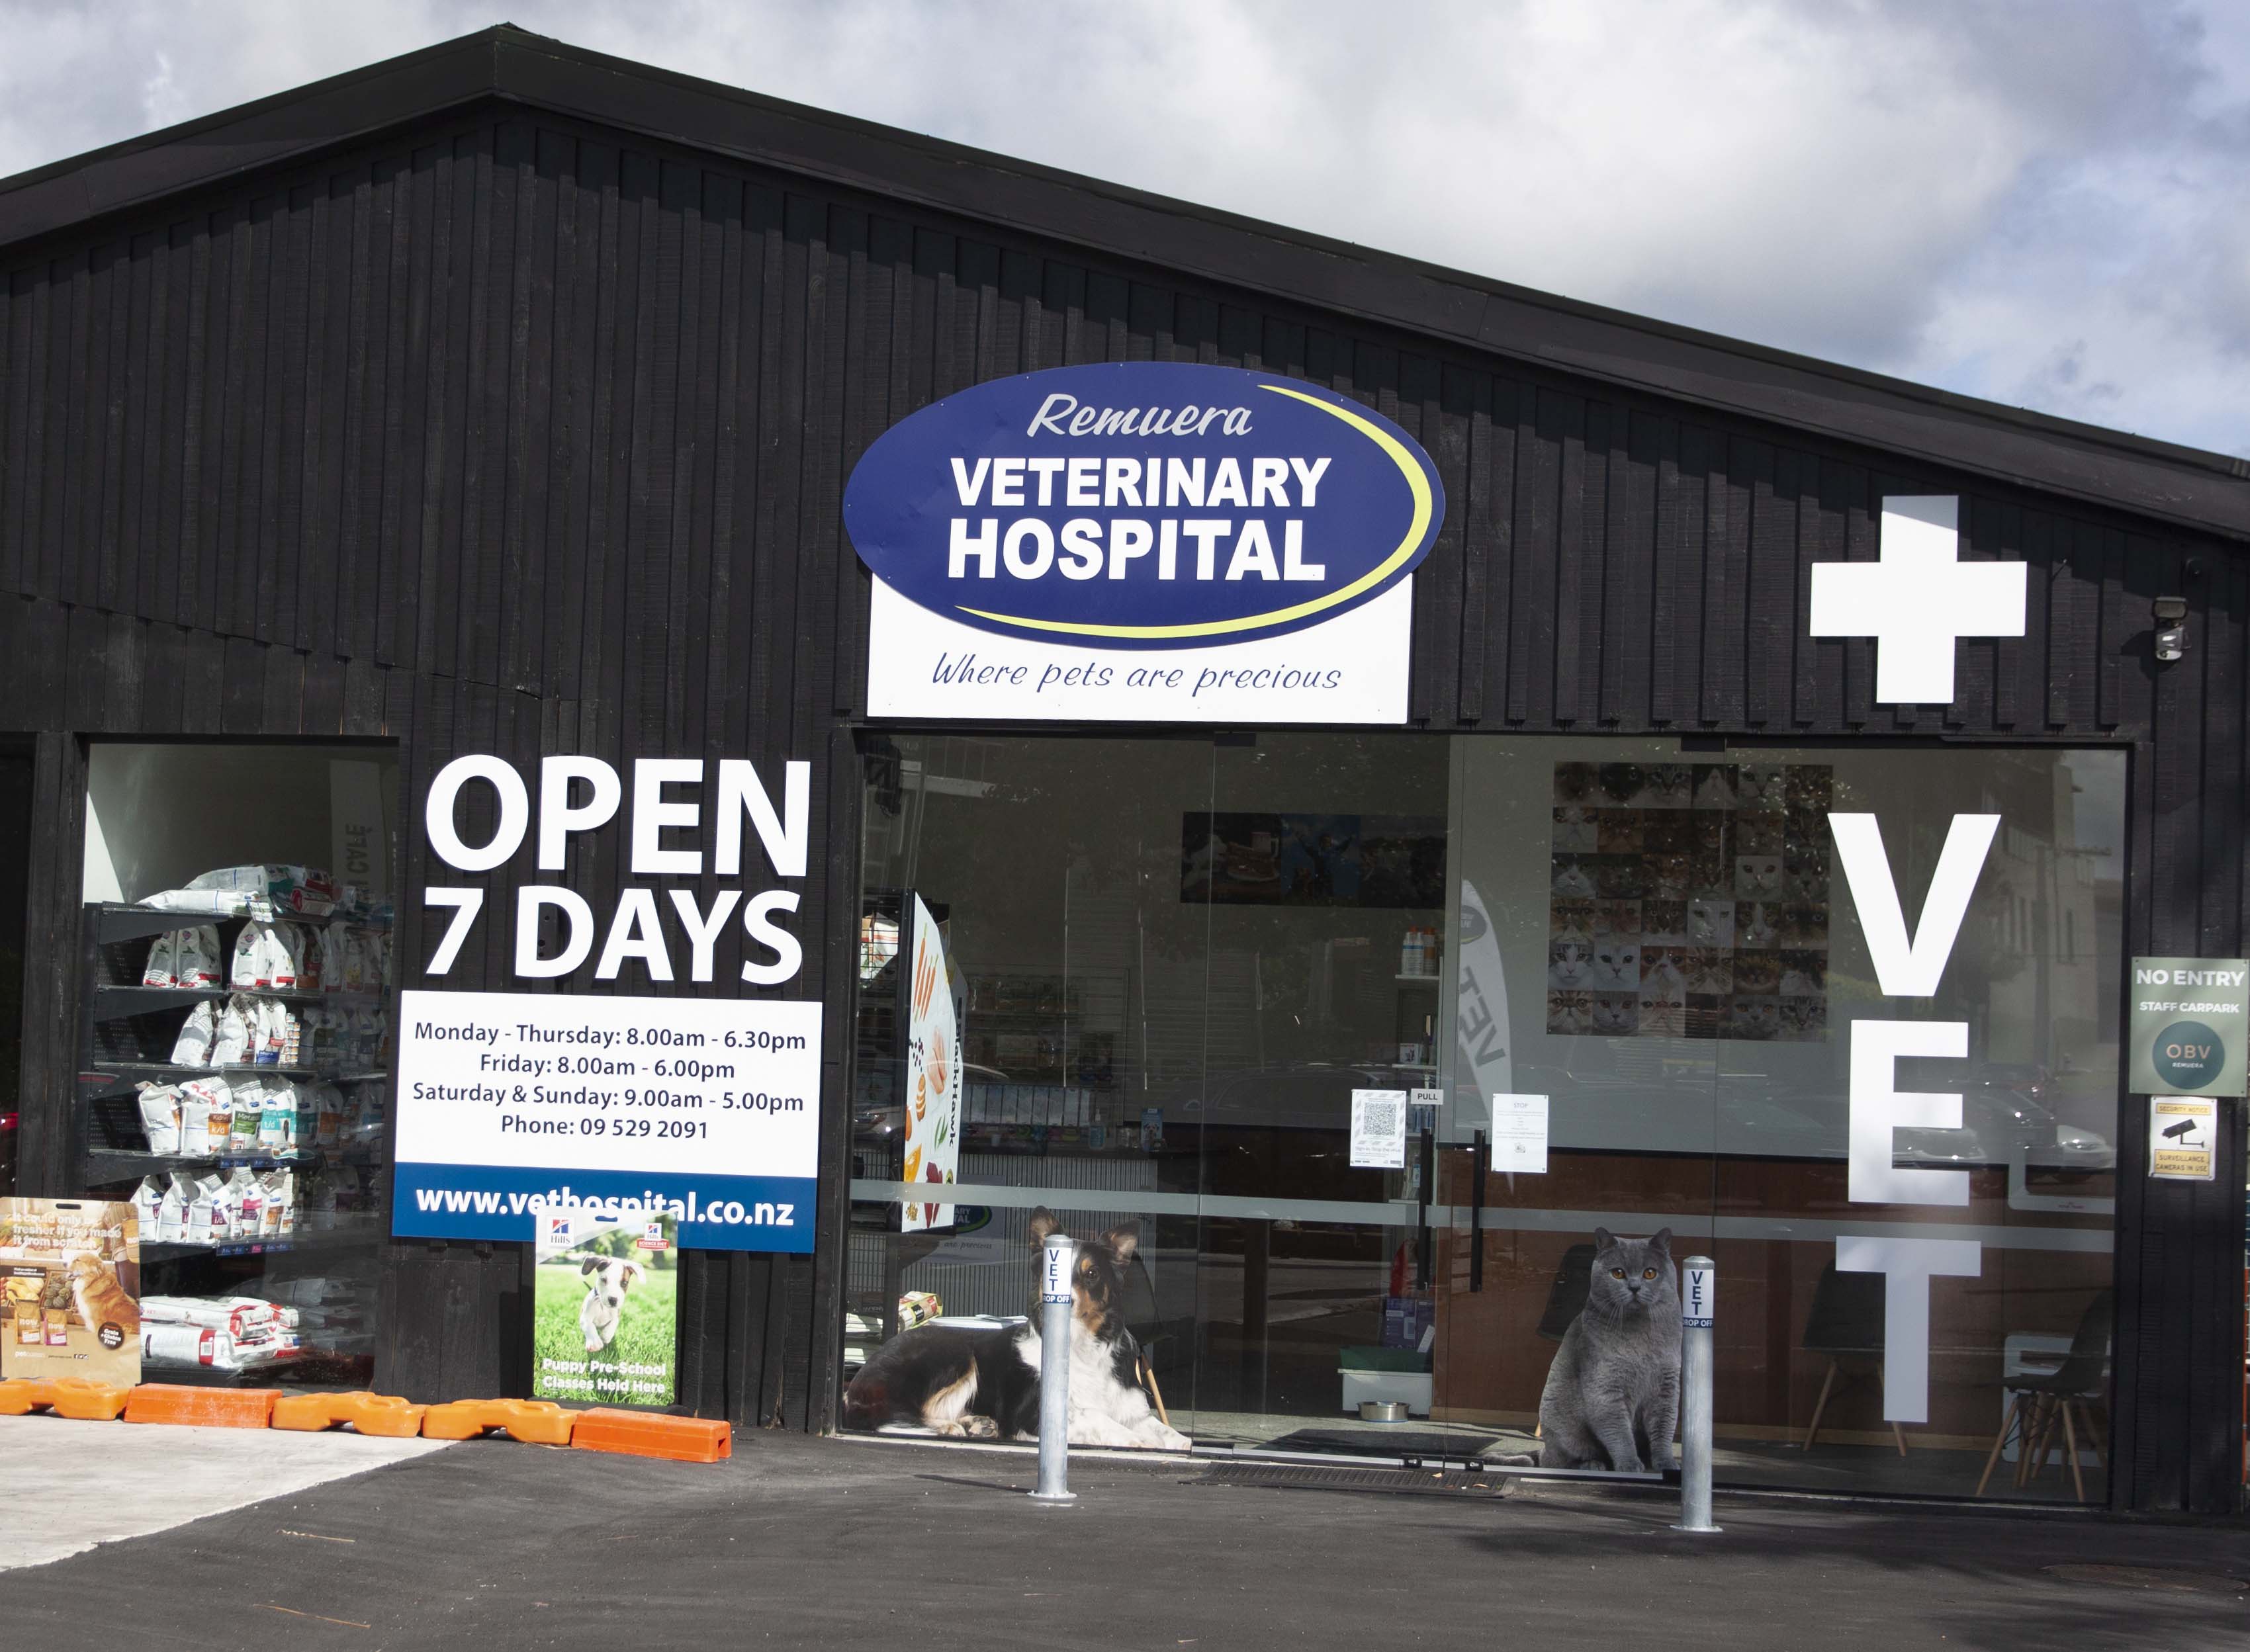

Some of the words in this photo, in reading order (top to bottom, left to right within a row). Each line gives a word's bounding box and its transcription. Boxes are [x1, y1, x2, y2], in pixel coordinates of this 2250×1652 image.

[1027, 393, 1253, 437] Remuera
[950, 457, 1332, 508] VETERINARY
[948, 517, 1326, 582] HOSPITAL
[932, 652, 1027, 687] Where
[1037, 660, 1114, 693] pets
[1126, 666, 1184, 689] are
[1192, 663, 1342, 697] precious
[426, 754, 811, 877] OPEN
[425, 887, 484, 975] 7
[515, 885, 803, 985] DAYS
[2136, 969, 2169, 985] NO
[2173, 970, 2245, 986] ENTRY
[2139, 1001, 2178, 1012] STAFF
[2179, 1002, 2240, 1014] CARPARK
[415, 1022, 499, 1047] Monday
[516, 1023, 621, 1049] Thursday:
[626, 1027, 705, 1047] 8.00am
[724, 1030, 806, 1054] 6.30pm
[2166, 1044, 2212, 1059] OBV
[480, 1054, 552, 1078] Friday:
[557, 1057, 635, 1075] 8.00am
[654, 1059, 735, 1082] 6.00pm
[413, 1082, 506, 1107] Saturday
[512, 1084, 527, 1103] &
[533, 1086, 618, 1110] Sunday:
[623, 1088, 703, 1108] 9.00am
[722, 1092, 803, 1115] 5.00pm
[502, 1115, 574, 1135] Phone:
[580, 1118, 606, 1135] 09
[612, 1119, 651, 1137] 529
[656, 1121, 707, 1139] 2091
[1827, 812, 2002, 1423] VET
[13, 1225, 56, 1235] fresher
[67, 1227, 88, 1239] you
[90, 1227, 122, 1239] made
[24, 1213, 56, 1224] could
[58, 1214, 81, 1227] only
[23, 1235, 51, 1246] from
[1049, 1249, 1059, 1291] VET
[1691, 1271, 1703, 1315] VET
[542, 1358, 587, 1374] Puppy
[590, 1360, 666, 1376] Pre-School
[542, 1375, 594, 1390] Classes
[597, 1378, 629, 1391] Held
[633, 1380, 666, 1393] Here
